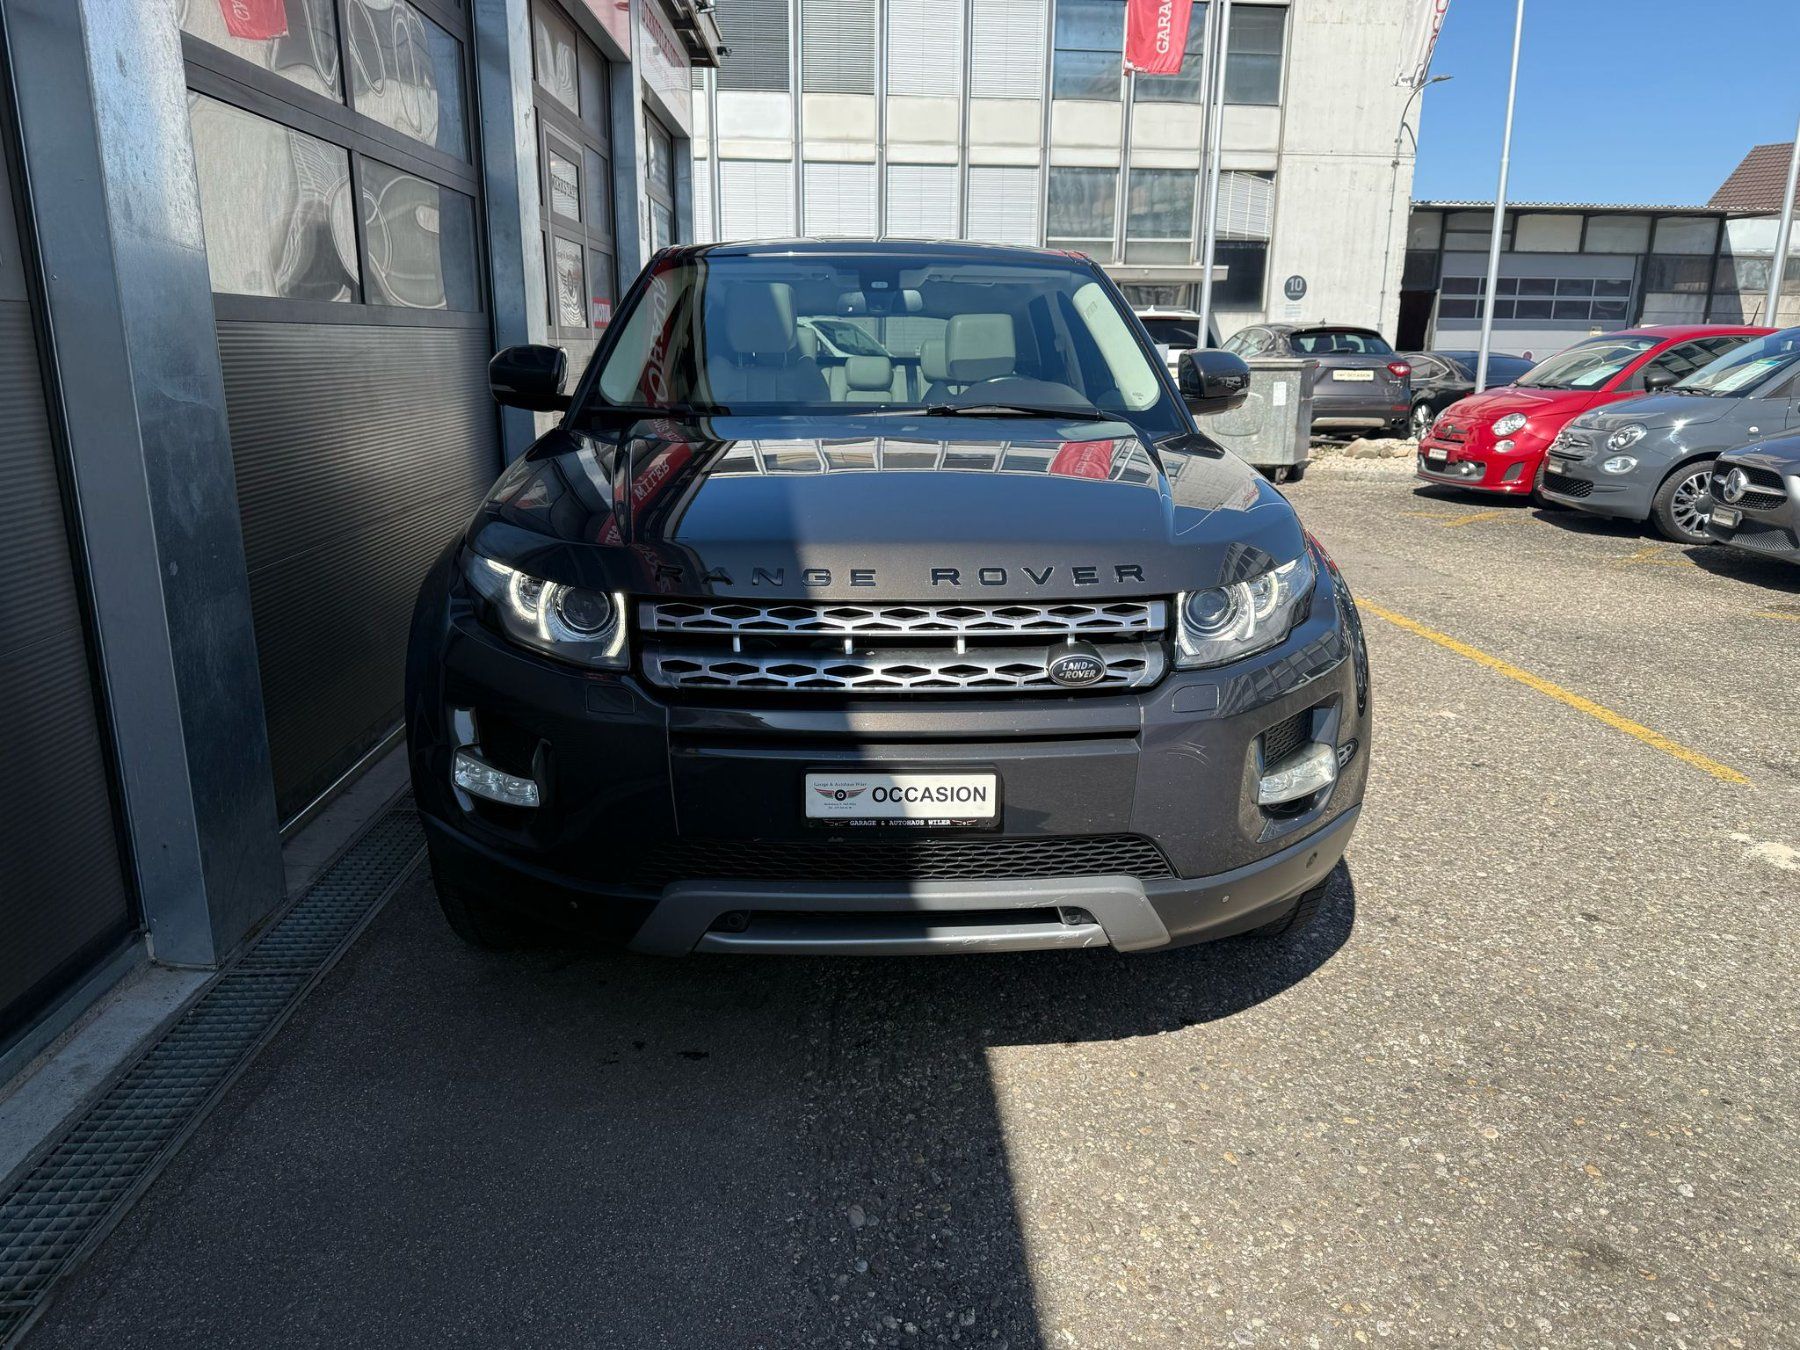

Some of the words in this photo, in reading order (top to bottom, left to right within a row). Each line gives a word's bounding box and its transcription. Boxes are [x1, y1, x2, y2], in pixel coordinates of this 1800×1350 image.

[1156, 0, 1173, 54] GARA
[1289, 278, 1303, 291] 10
[655, 564, 877, 587] RANGE
[930, 564, 1146, 586] ROVER
[1062, 661, 1088, 671] LAND
[1064, 669, 1096, 679] ROVER
[872, 786, 987, 803] OCCASION
[928, 819, 951, 827] WILER
